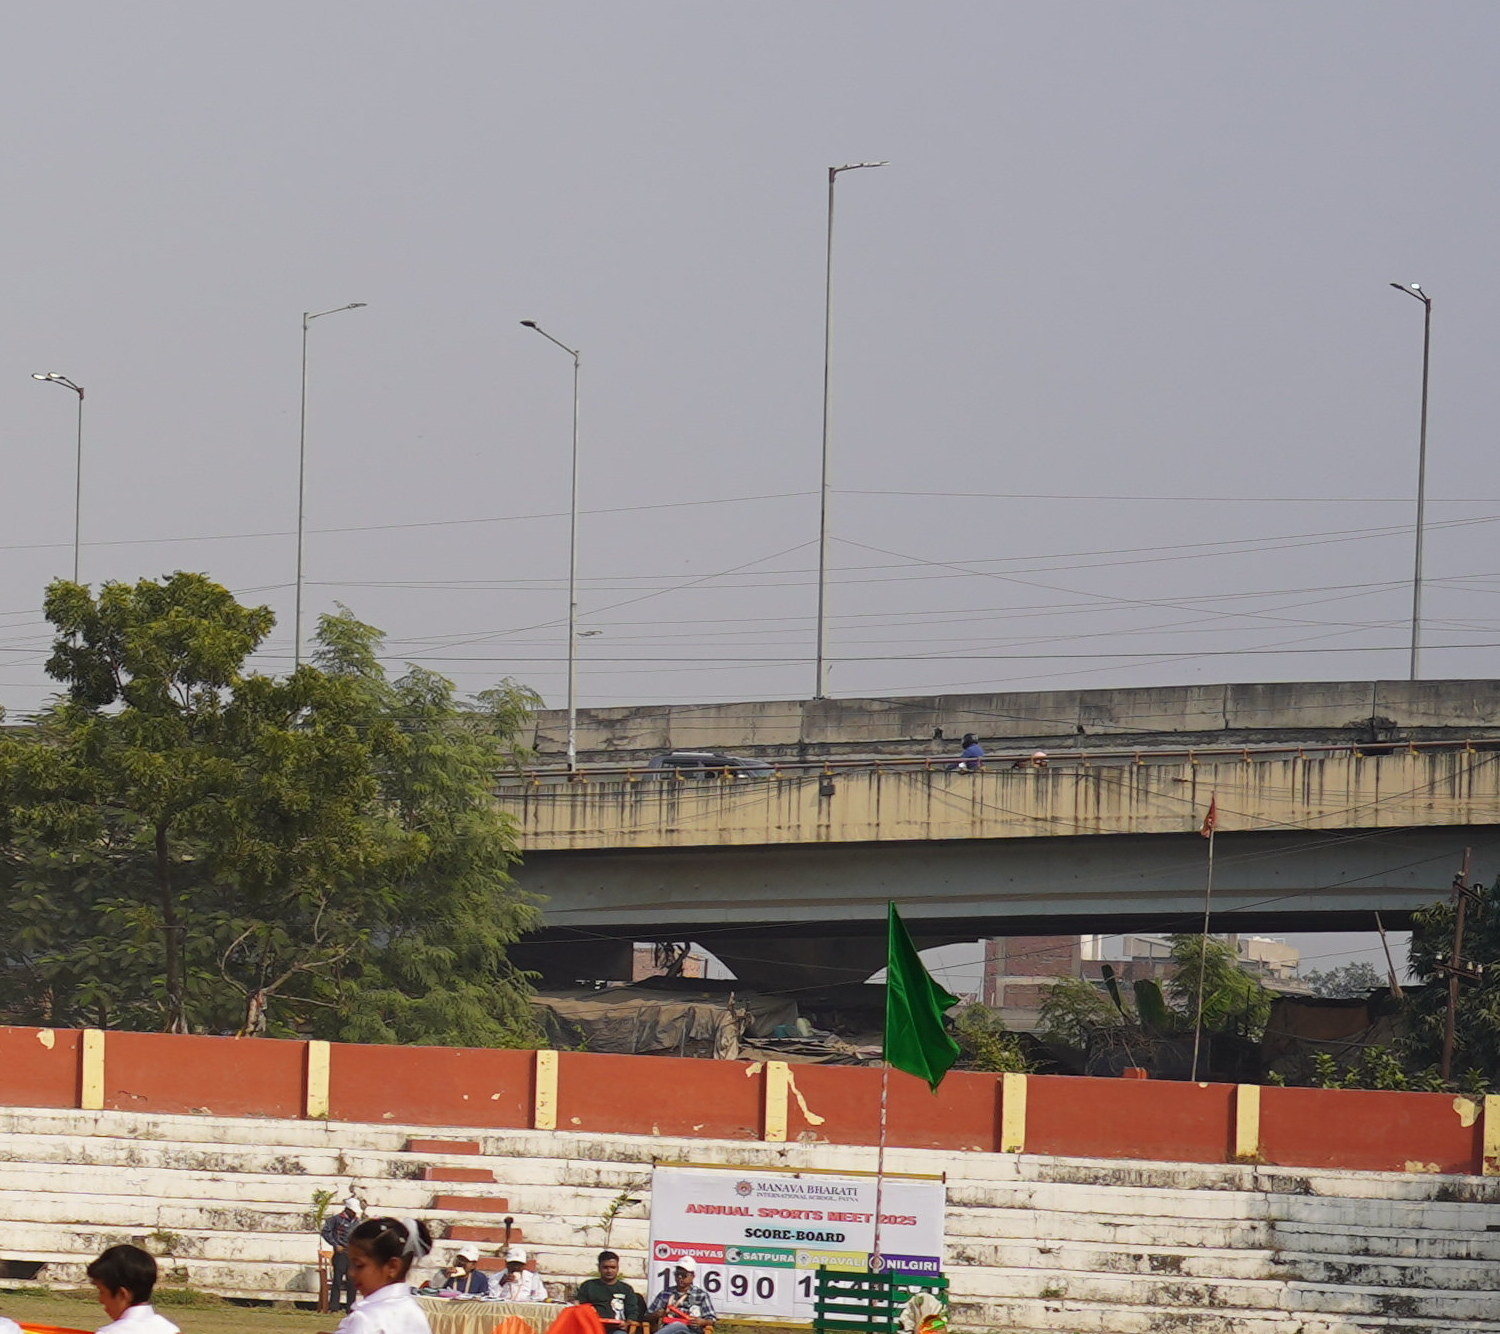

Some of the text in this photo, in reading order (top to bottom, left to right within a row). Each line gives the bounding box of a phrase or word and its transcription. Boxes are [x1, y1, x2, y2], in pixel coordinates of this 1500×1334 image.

[756, 1183, 859, 1196] MANAVA BHARATI
[685, 1204, 917, 1226] ANNUAL SPORTS MEET 2025
[744, 1228, 846, 1243] SCORE-BOARD
[670, 1248, 724, 1259] VINDHYAS
[743, 1252, 795, 1263] SATPURA
[811, 1255, 866, 1267] ARAVALI
[886, 1259, 938, 1271] NILGIRI
[657, 1268, 722, 1293] 16
[730, 1274, 775, 1299] 90
